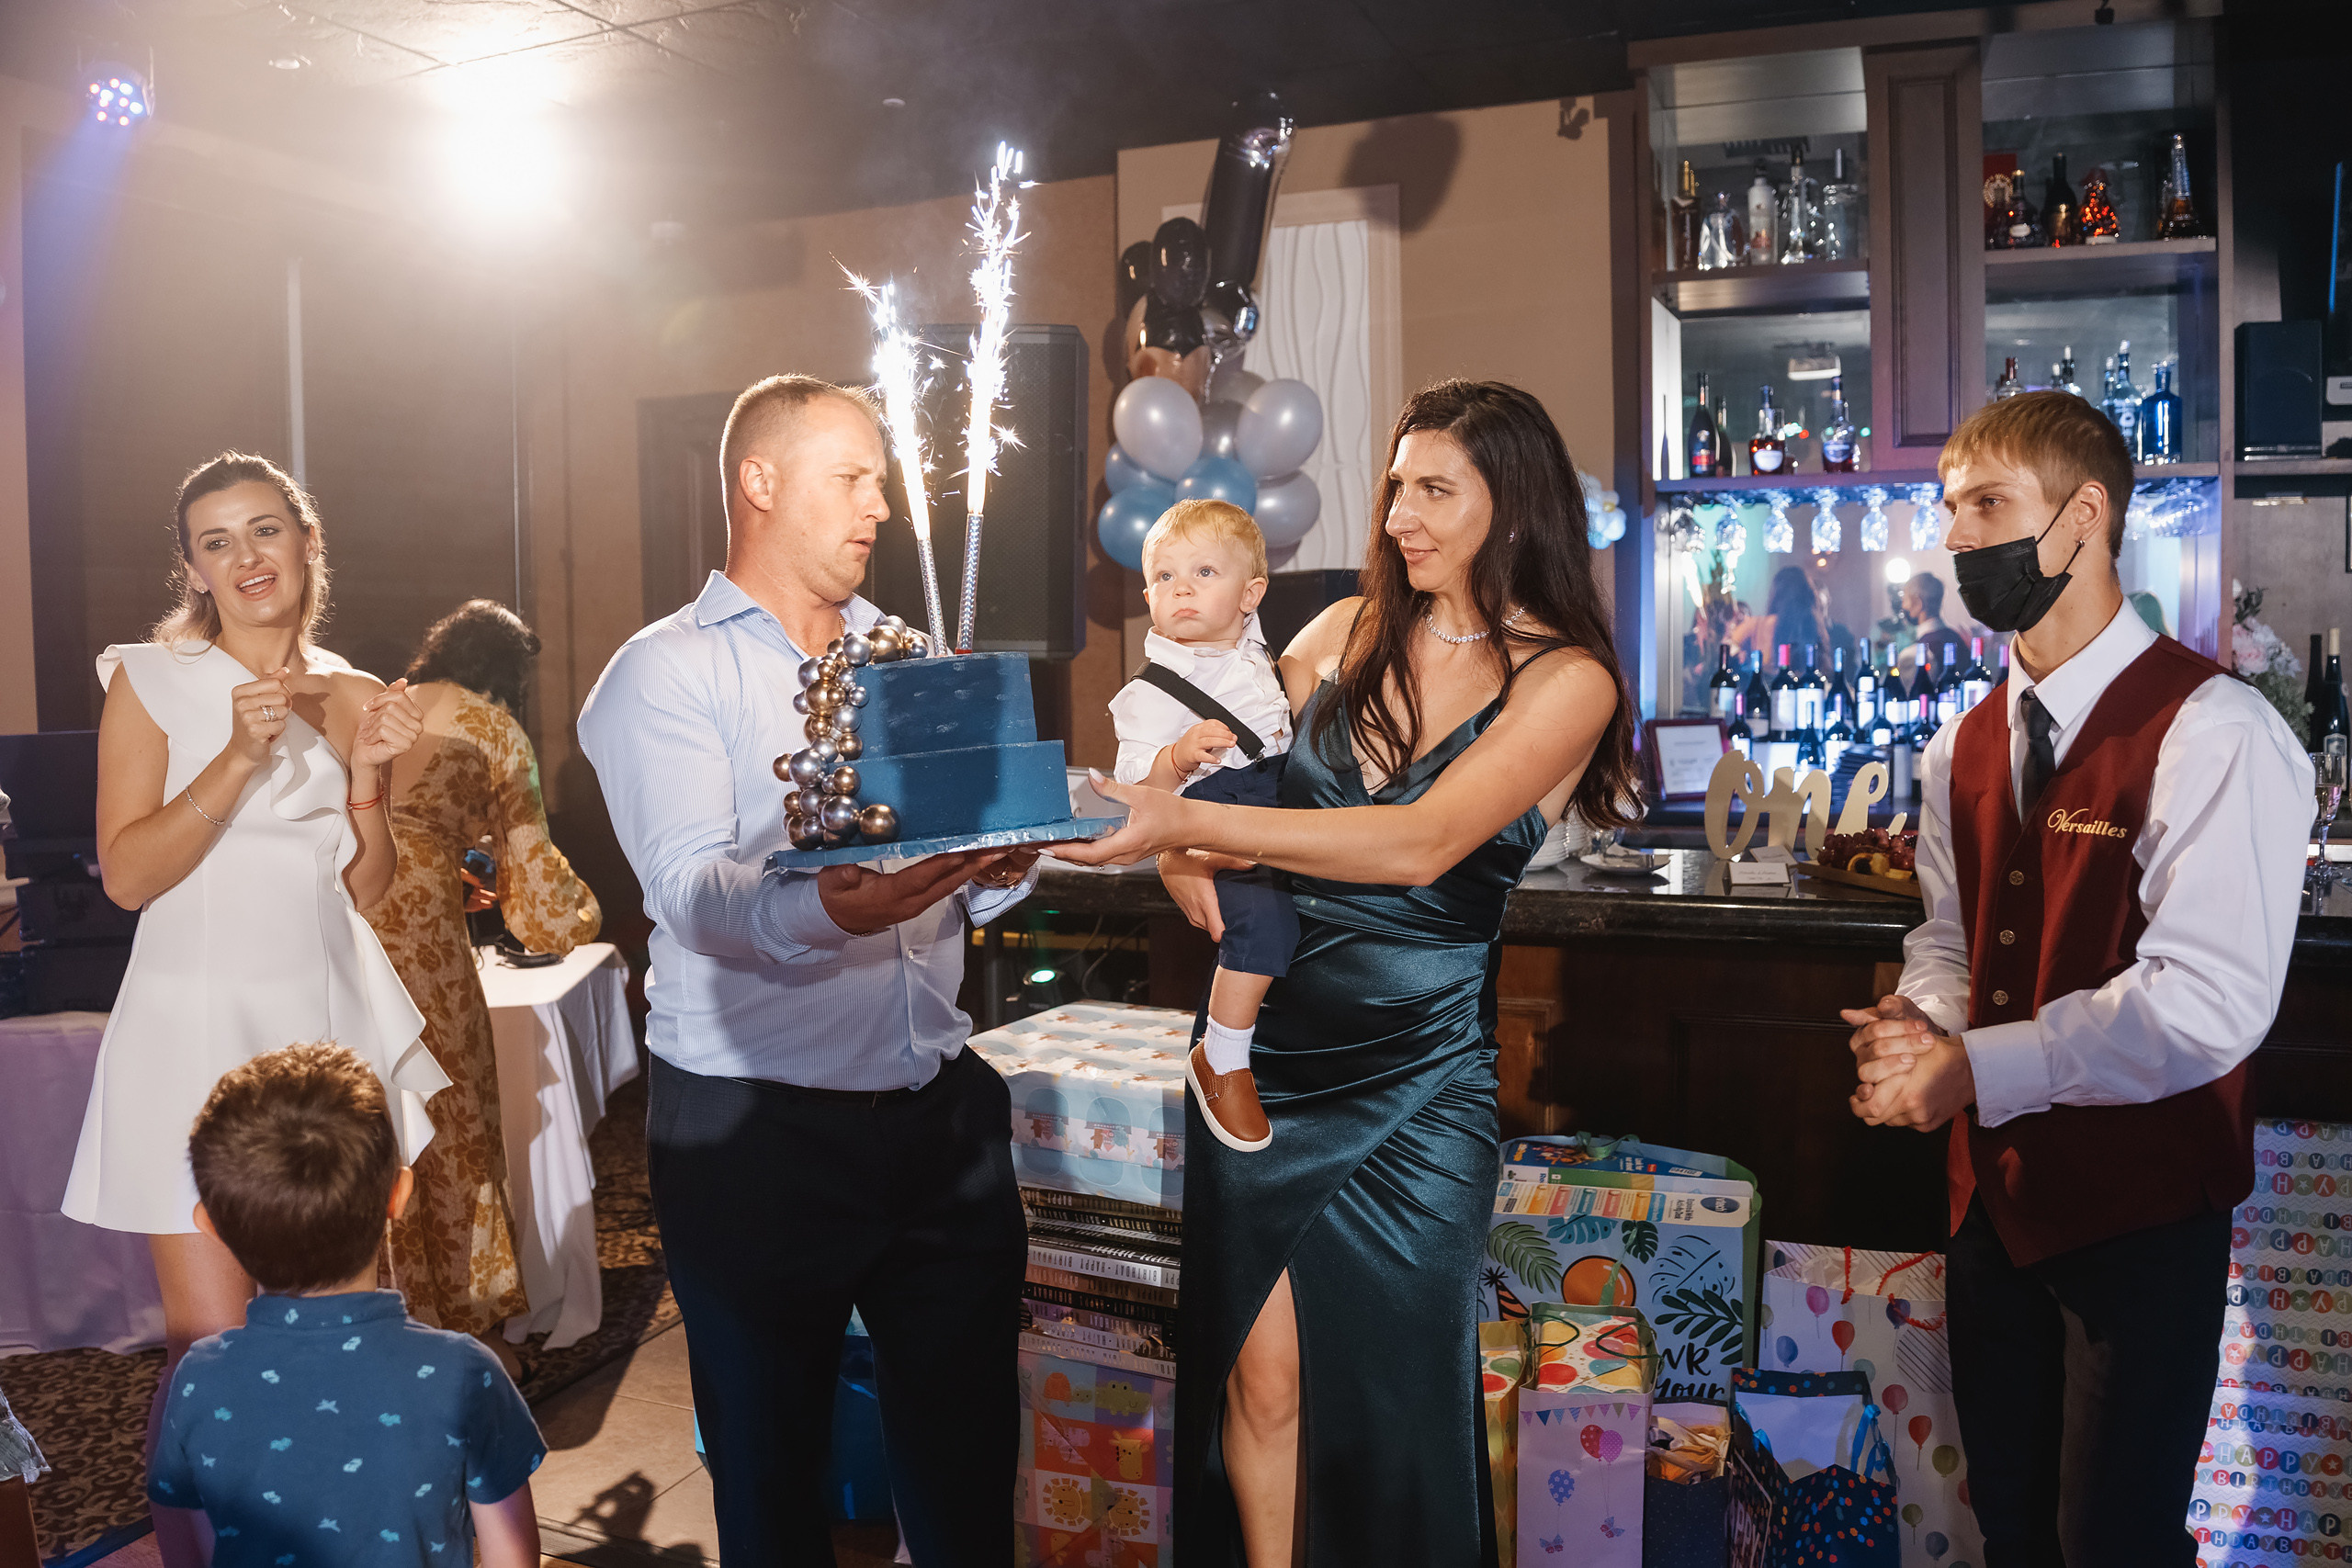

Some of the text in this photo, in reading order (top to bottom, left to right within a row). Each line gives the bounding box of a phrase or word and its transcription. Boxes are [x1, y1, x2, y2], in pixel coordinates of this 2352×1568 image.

[2047, 808, 2127, 839] Versailles
[1033, 1250, 1073, 1268] BIRTHDAY
[1080, 1258, 1106, 1273] HAPPY
[1114, 1264, 1158, 1282] BIRTHDAY
[2219, 1443, 2319, 1474] HAPPY
[2217, 1472, 2340, 1499] BIRTHDAY
